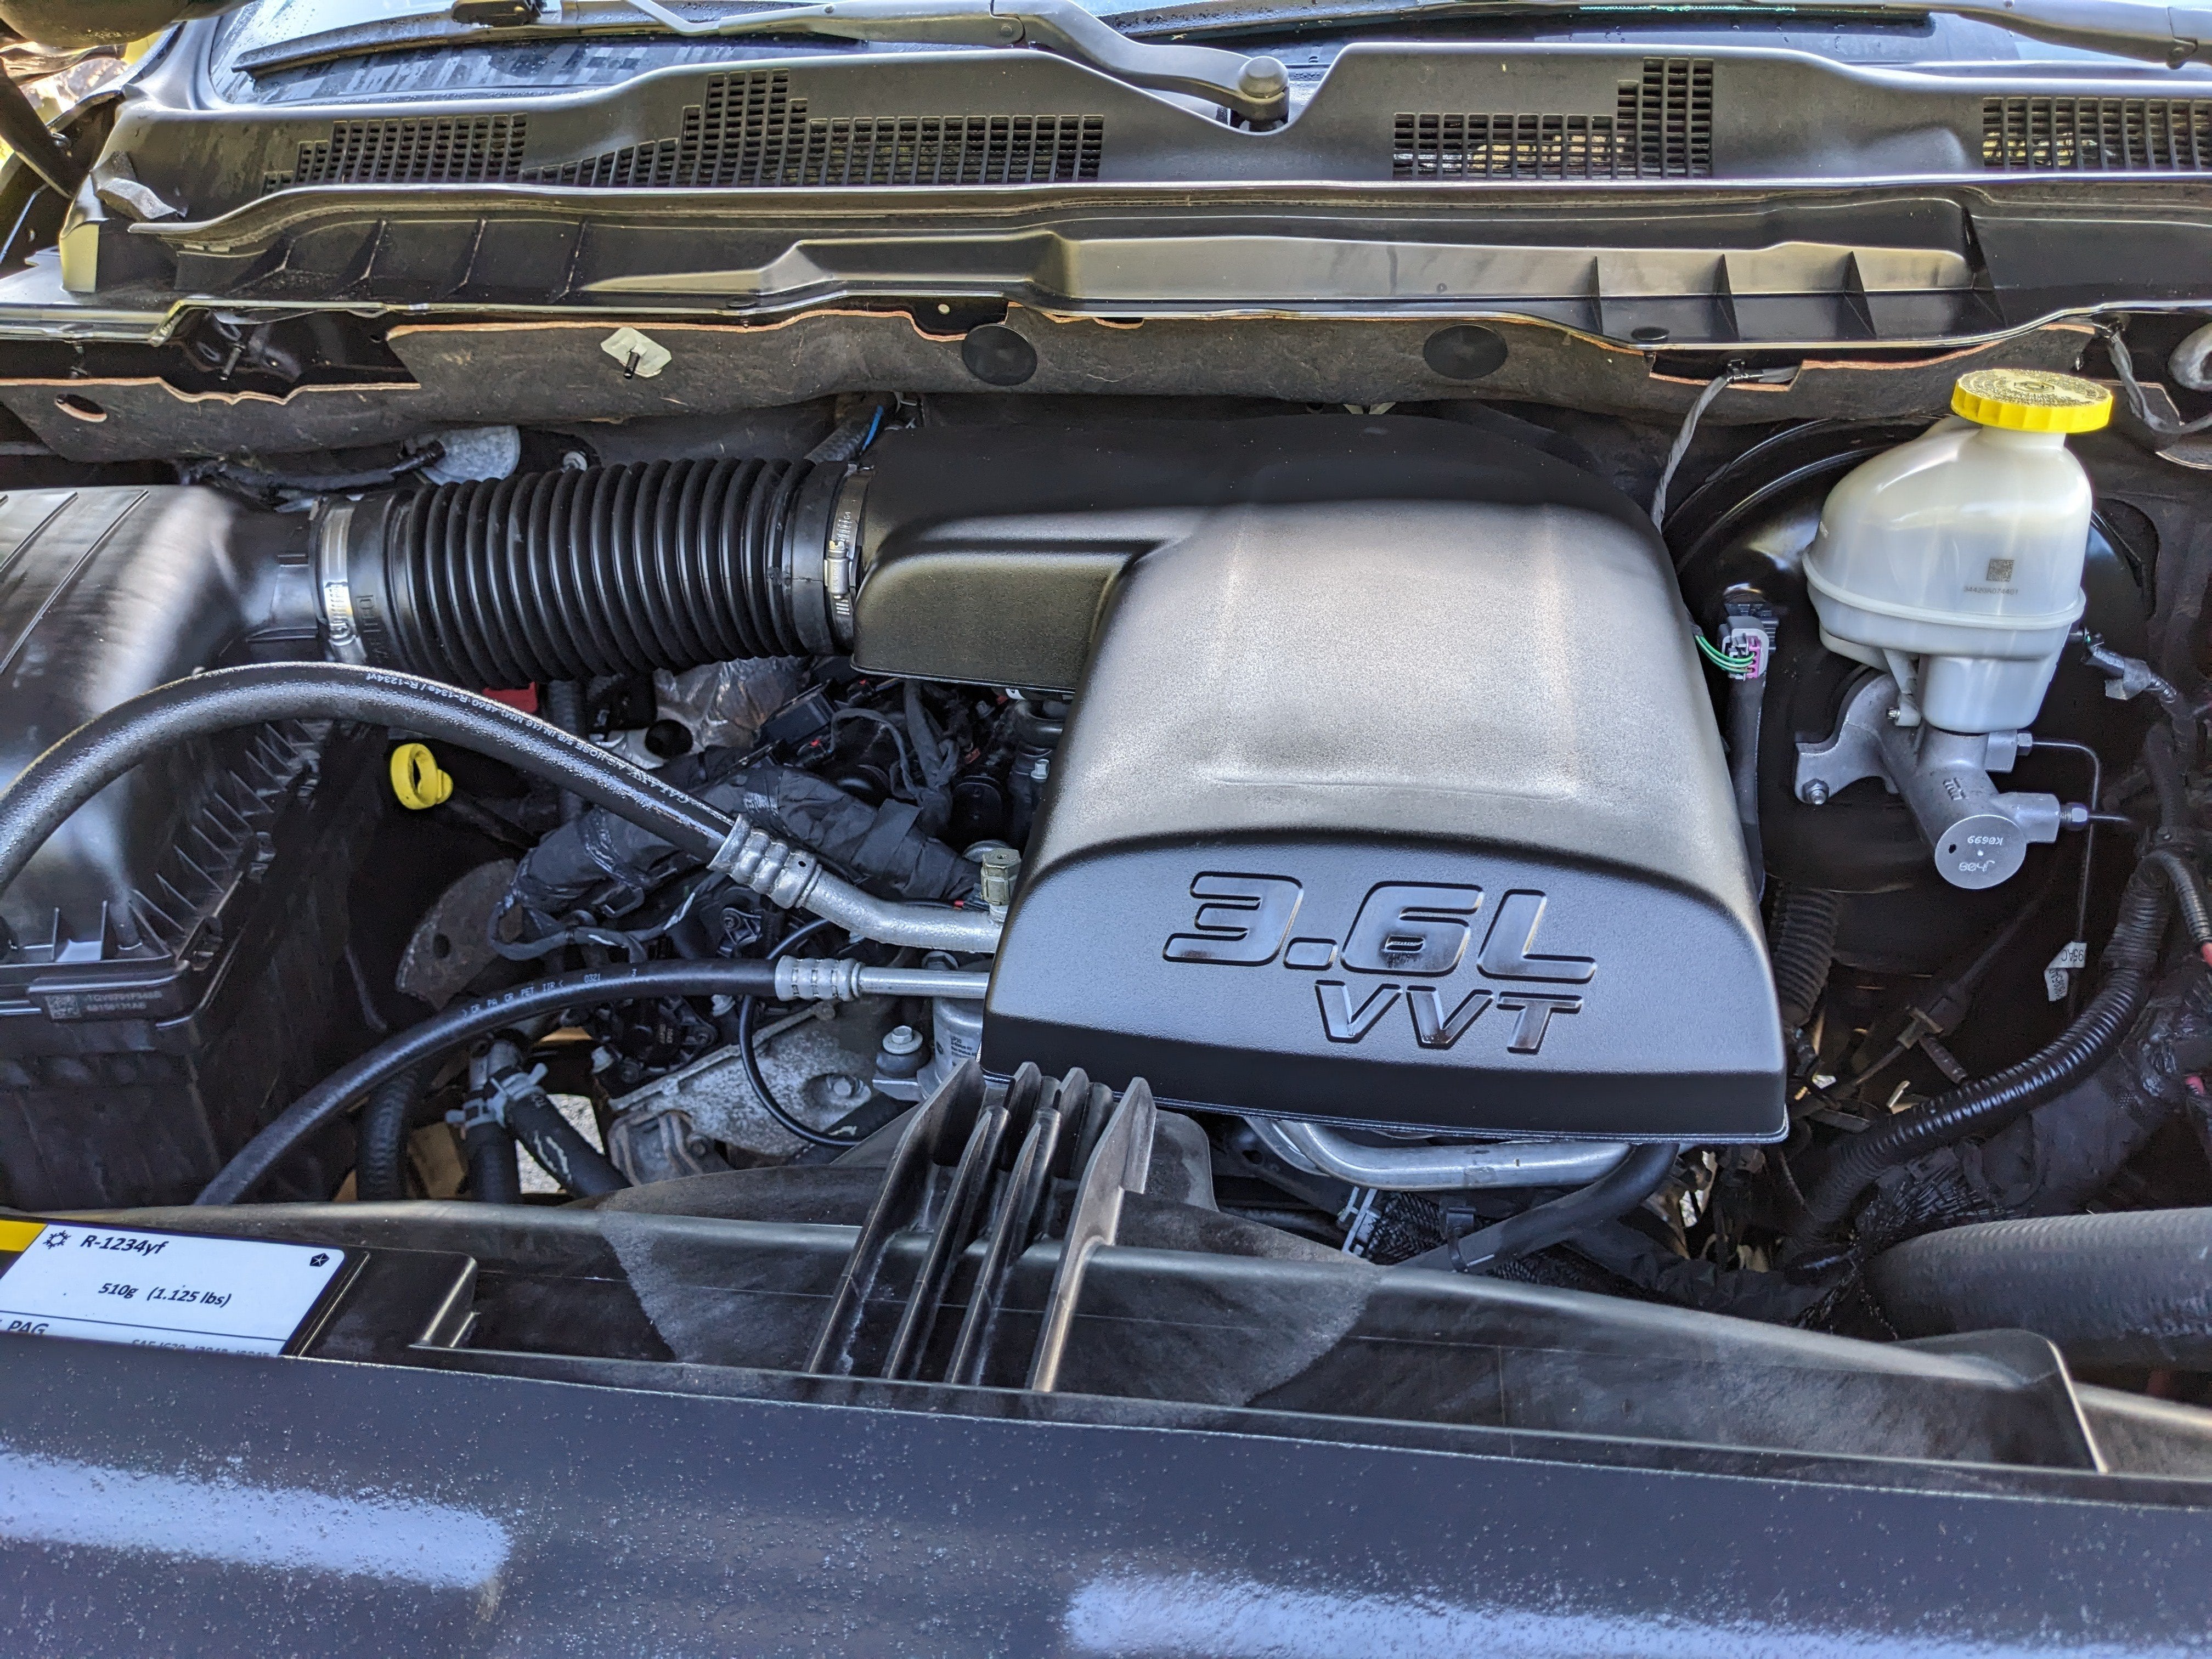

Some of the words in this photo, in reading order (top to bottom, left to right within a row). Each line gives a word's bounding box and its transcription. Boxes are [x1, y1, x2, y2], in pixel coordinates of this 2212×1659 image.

[365, 673, 419, 690] R-1234yf
[471, 699, 499, 713] 4860
[575, 743, 605, 761] HOSE
[1162, 871, 1598, 984] 3.6L
[1315, 979, 1584, 1054] VVT
[80, 1234, 170, 1256] R-1234yf
[98, 1282, 139, 1299] 510g
[146, 1286, 201, 1303] (1.125
[199, 1291, 232, 1308] lbs)
[7, 1320, 49, 1336] PAG
